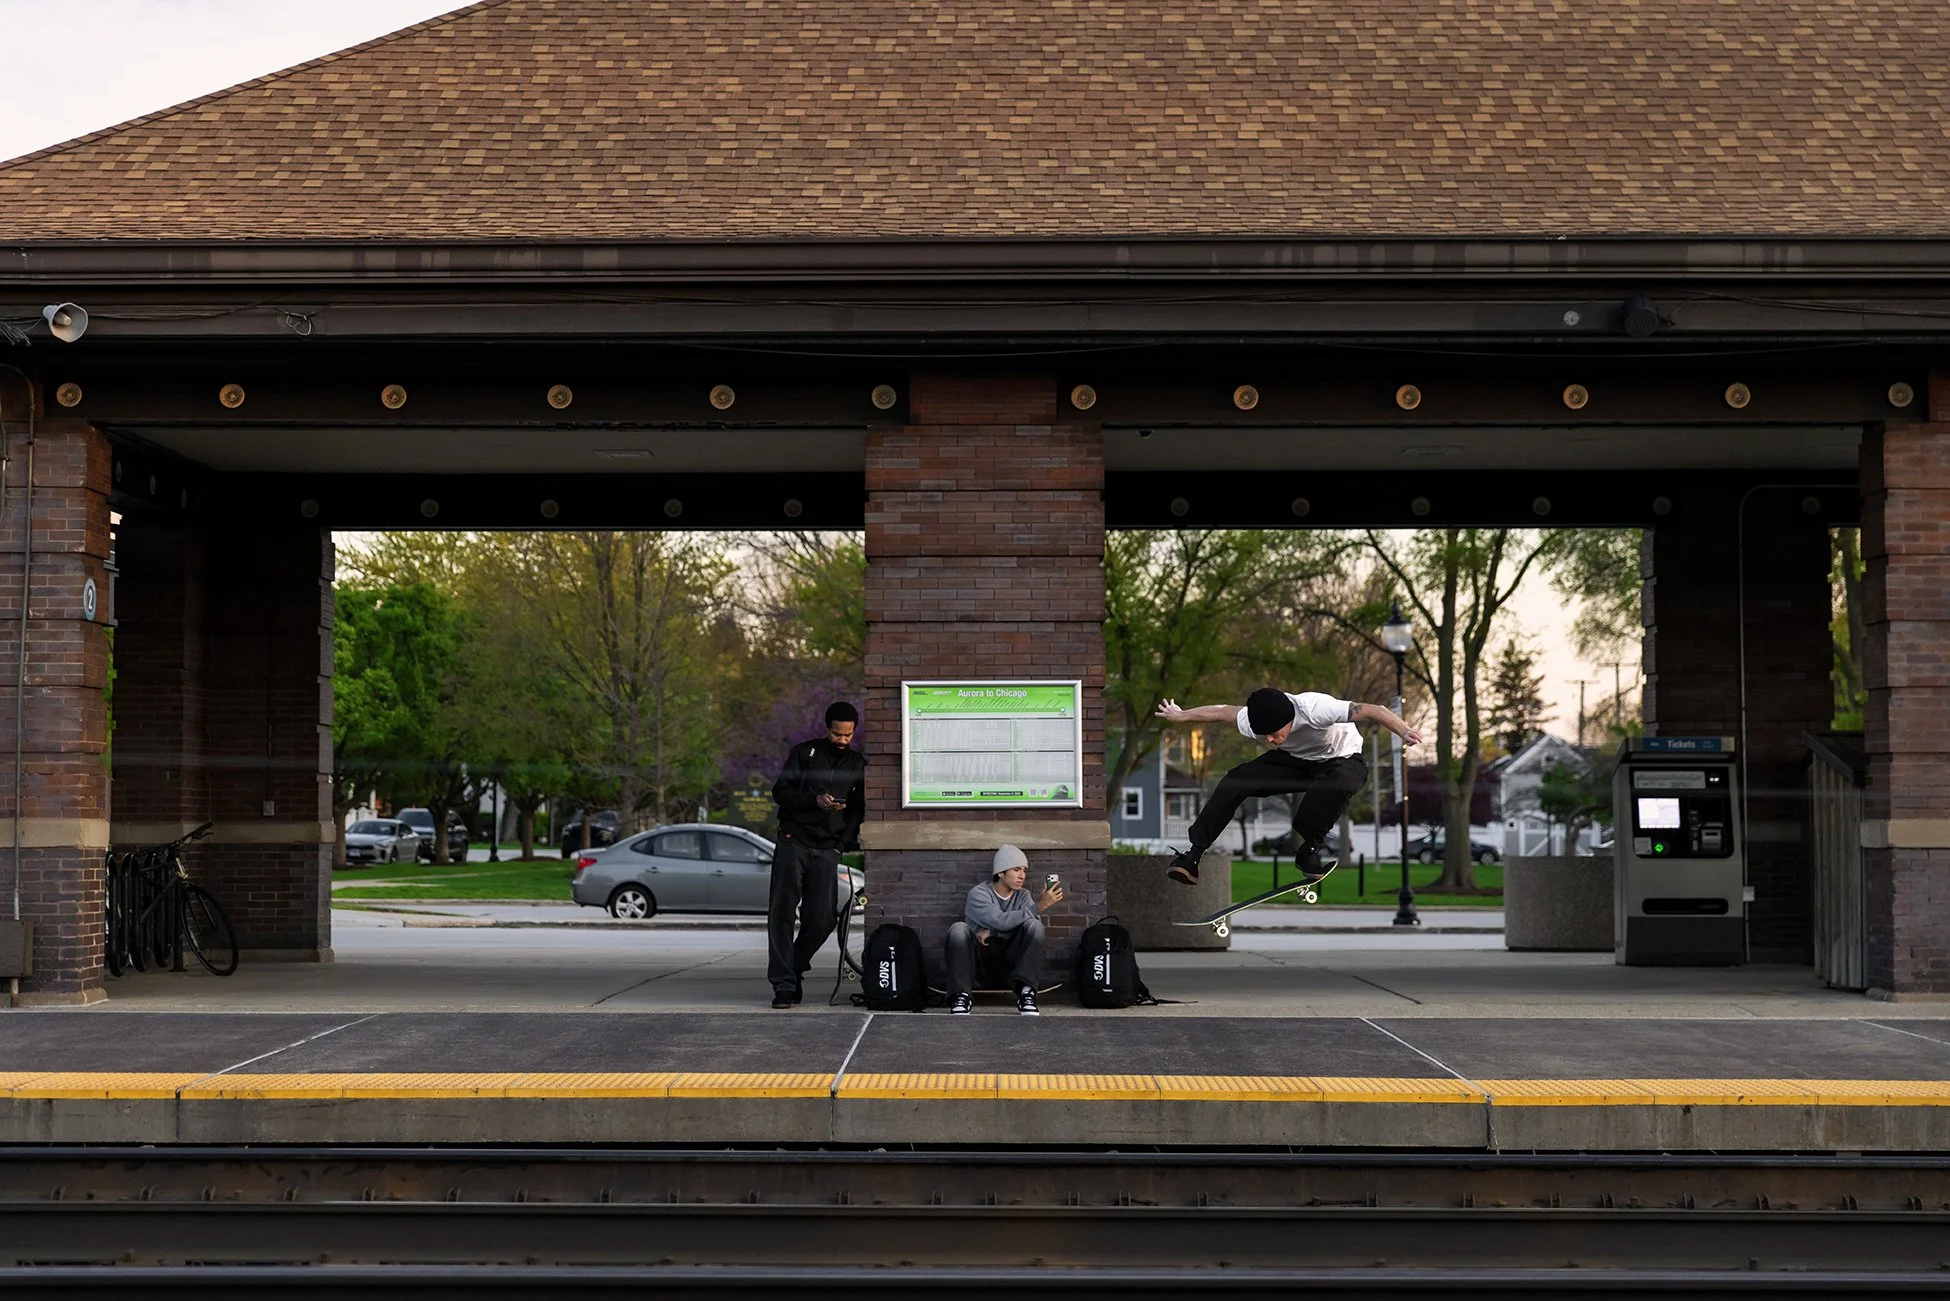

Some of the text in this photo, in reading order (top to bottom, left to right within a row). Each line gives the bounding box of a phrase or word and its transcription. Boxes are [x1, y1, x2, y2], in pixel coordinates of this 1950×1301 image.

[88, 589, 93, 610] 2
[957, 688, 984, 697] Aurora
[986, 688, 994, 697] to
[995, 688, 1028, 699] Chicago
[1667, 740, 1696, 749] Tickets
[879, 960, 890, 980] DVS
[1093, 954, 1104, 972] DVS
